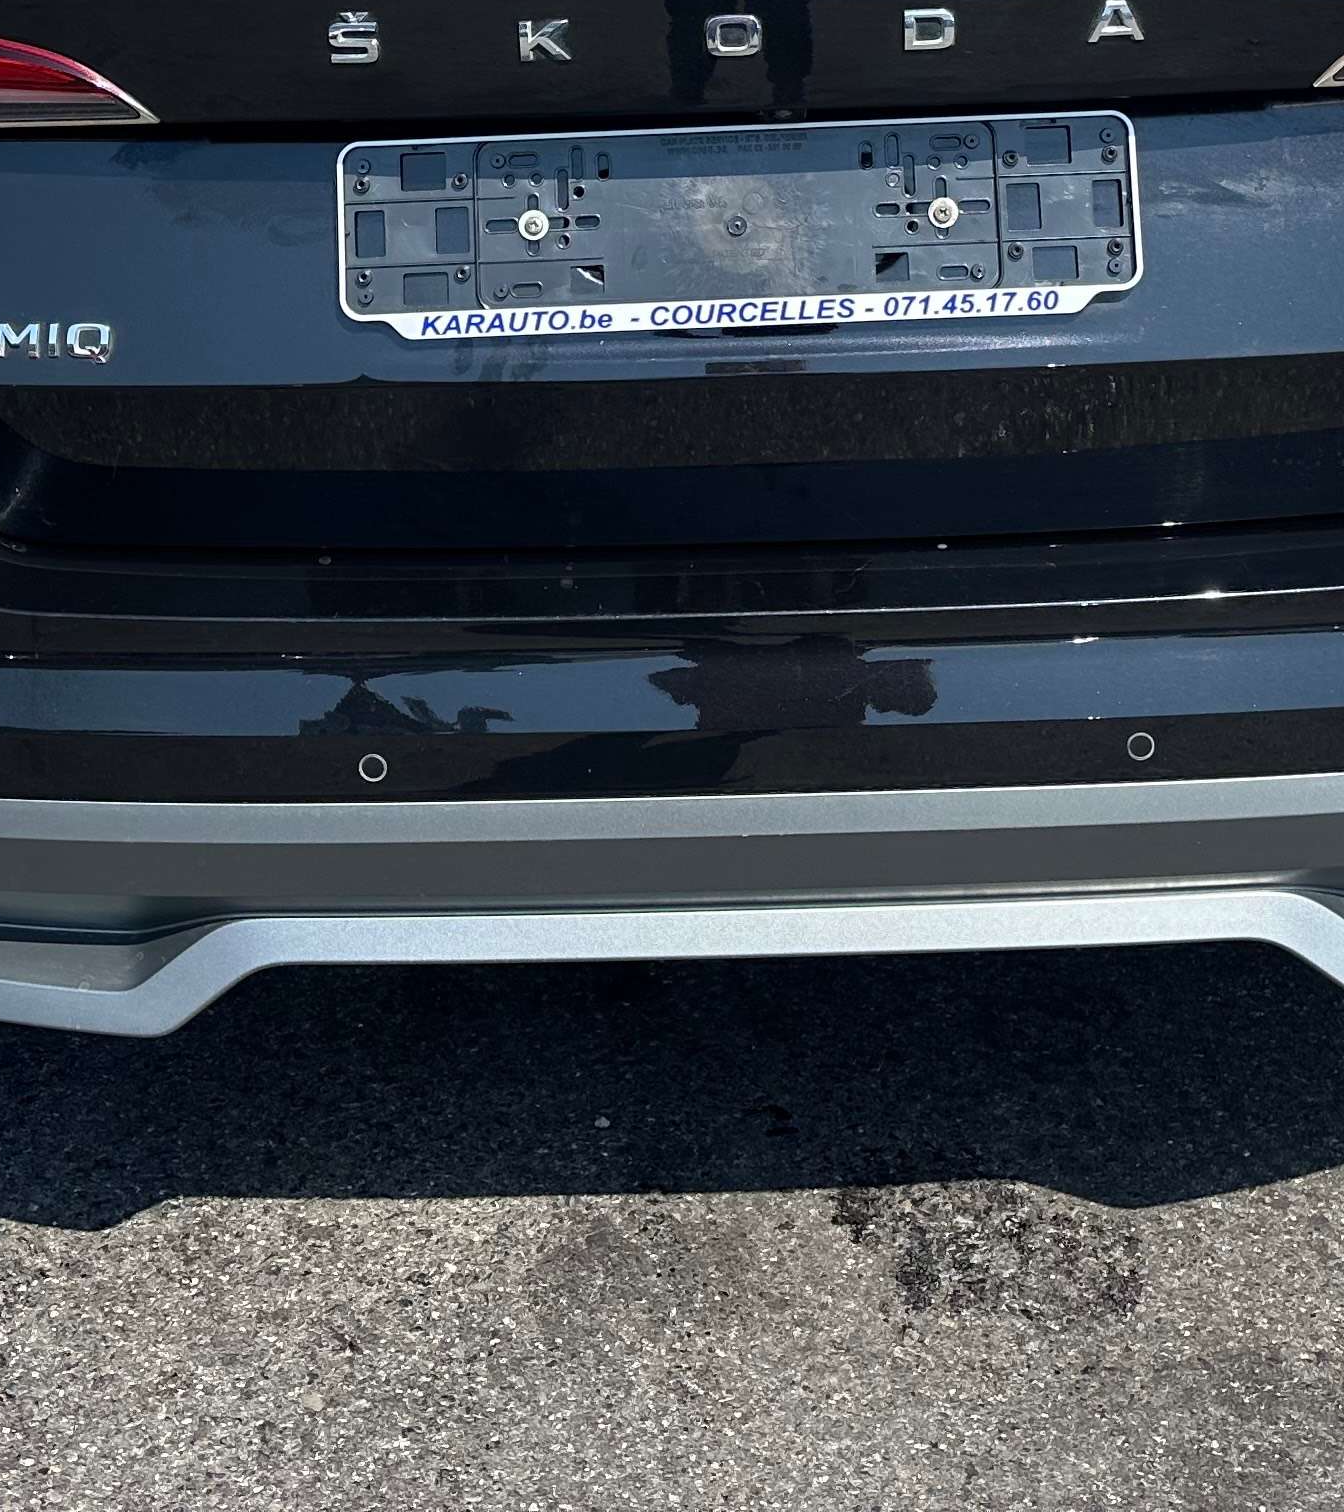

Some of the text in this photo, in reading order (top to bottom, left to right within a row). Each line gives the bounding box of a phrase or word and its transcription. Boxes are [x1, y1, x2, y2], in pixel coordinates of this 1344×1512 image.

[421, 309, 613, 336] KARAUTO.be
[650, 298, 855, 325] COURCELLES
[884, 290, 1059, 316] 071.45.17.60
